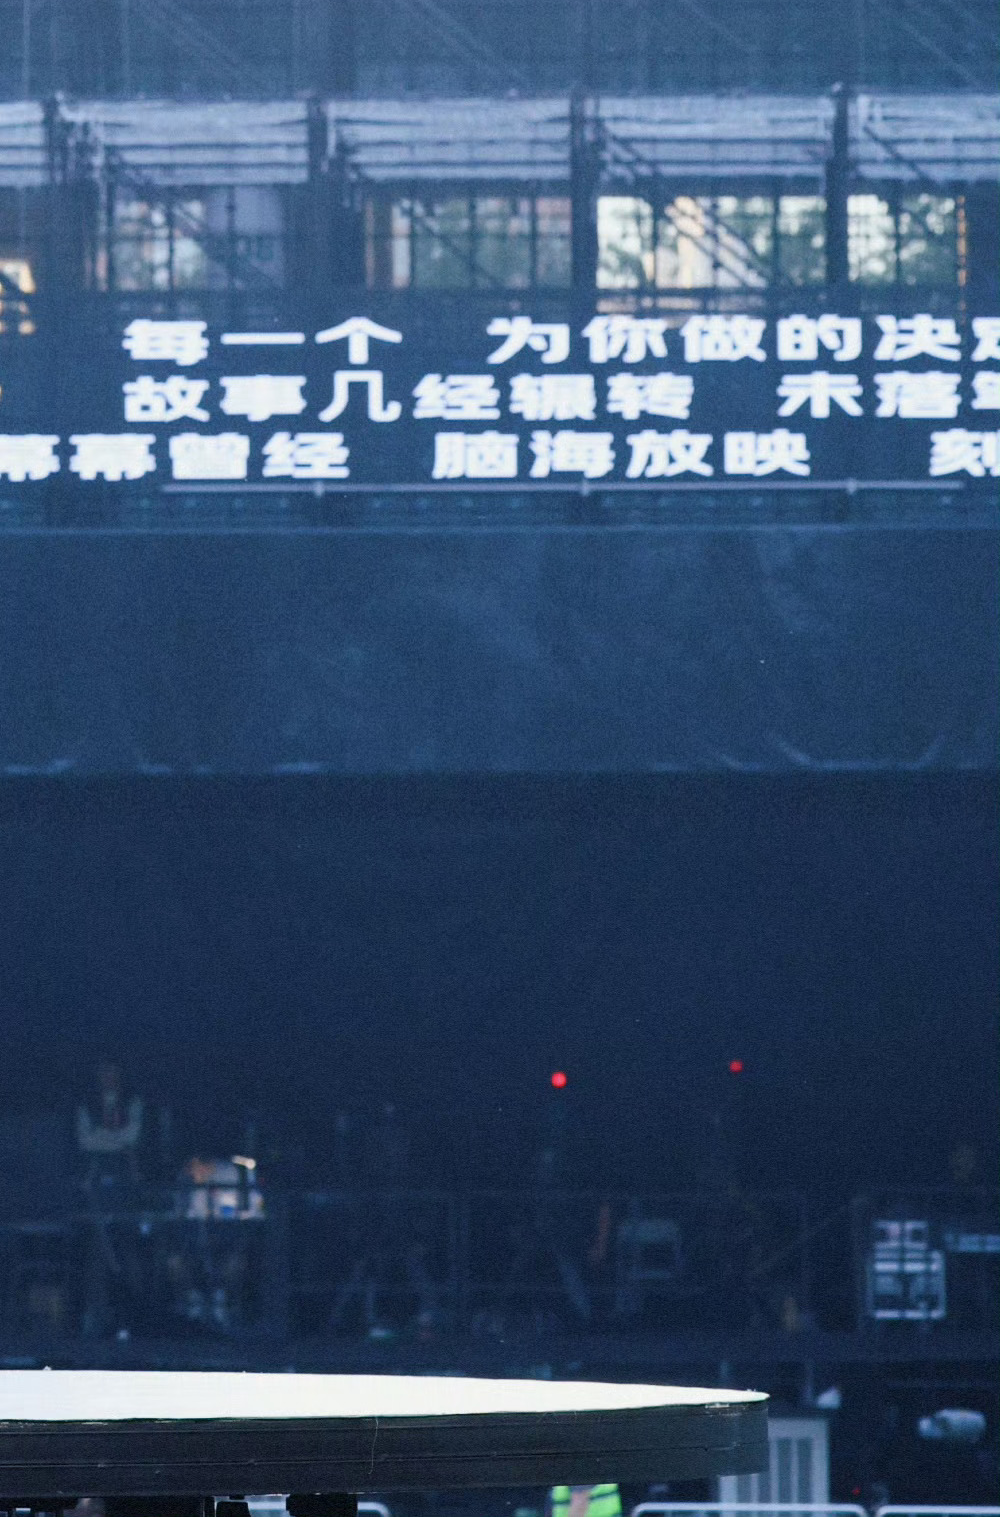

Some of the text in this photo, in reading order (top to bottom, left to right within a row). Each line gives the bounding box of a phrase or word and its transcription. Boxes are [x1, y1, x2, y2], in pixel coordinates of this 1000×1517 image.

[122, 317, 402, 366] 每一个
[122, 371, 695, 423] 故事几经辗转
[432, 428, 811, 479] 脑海放映
